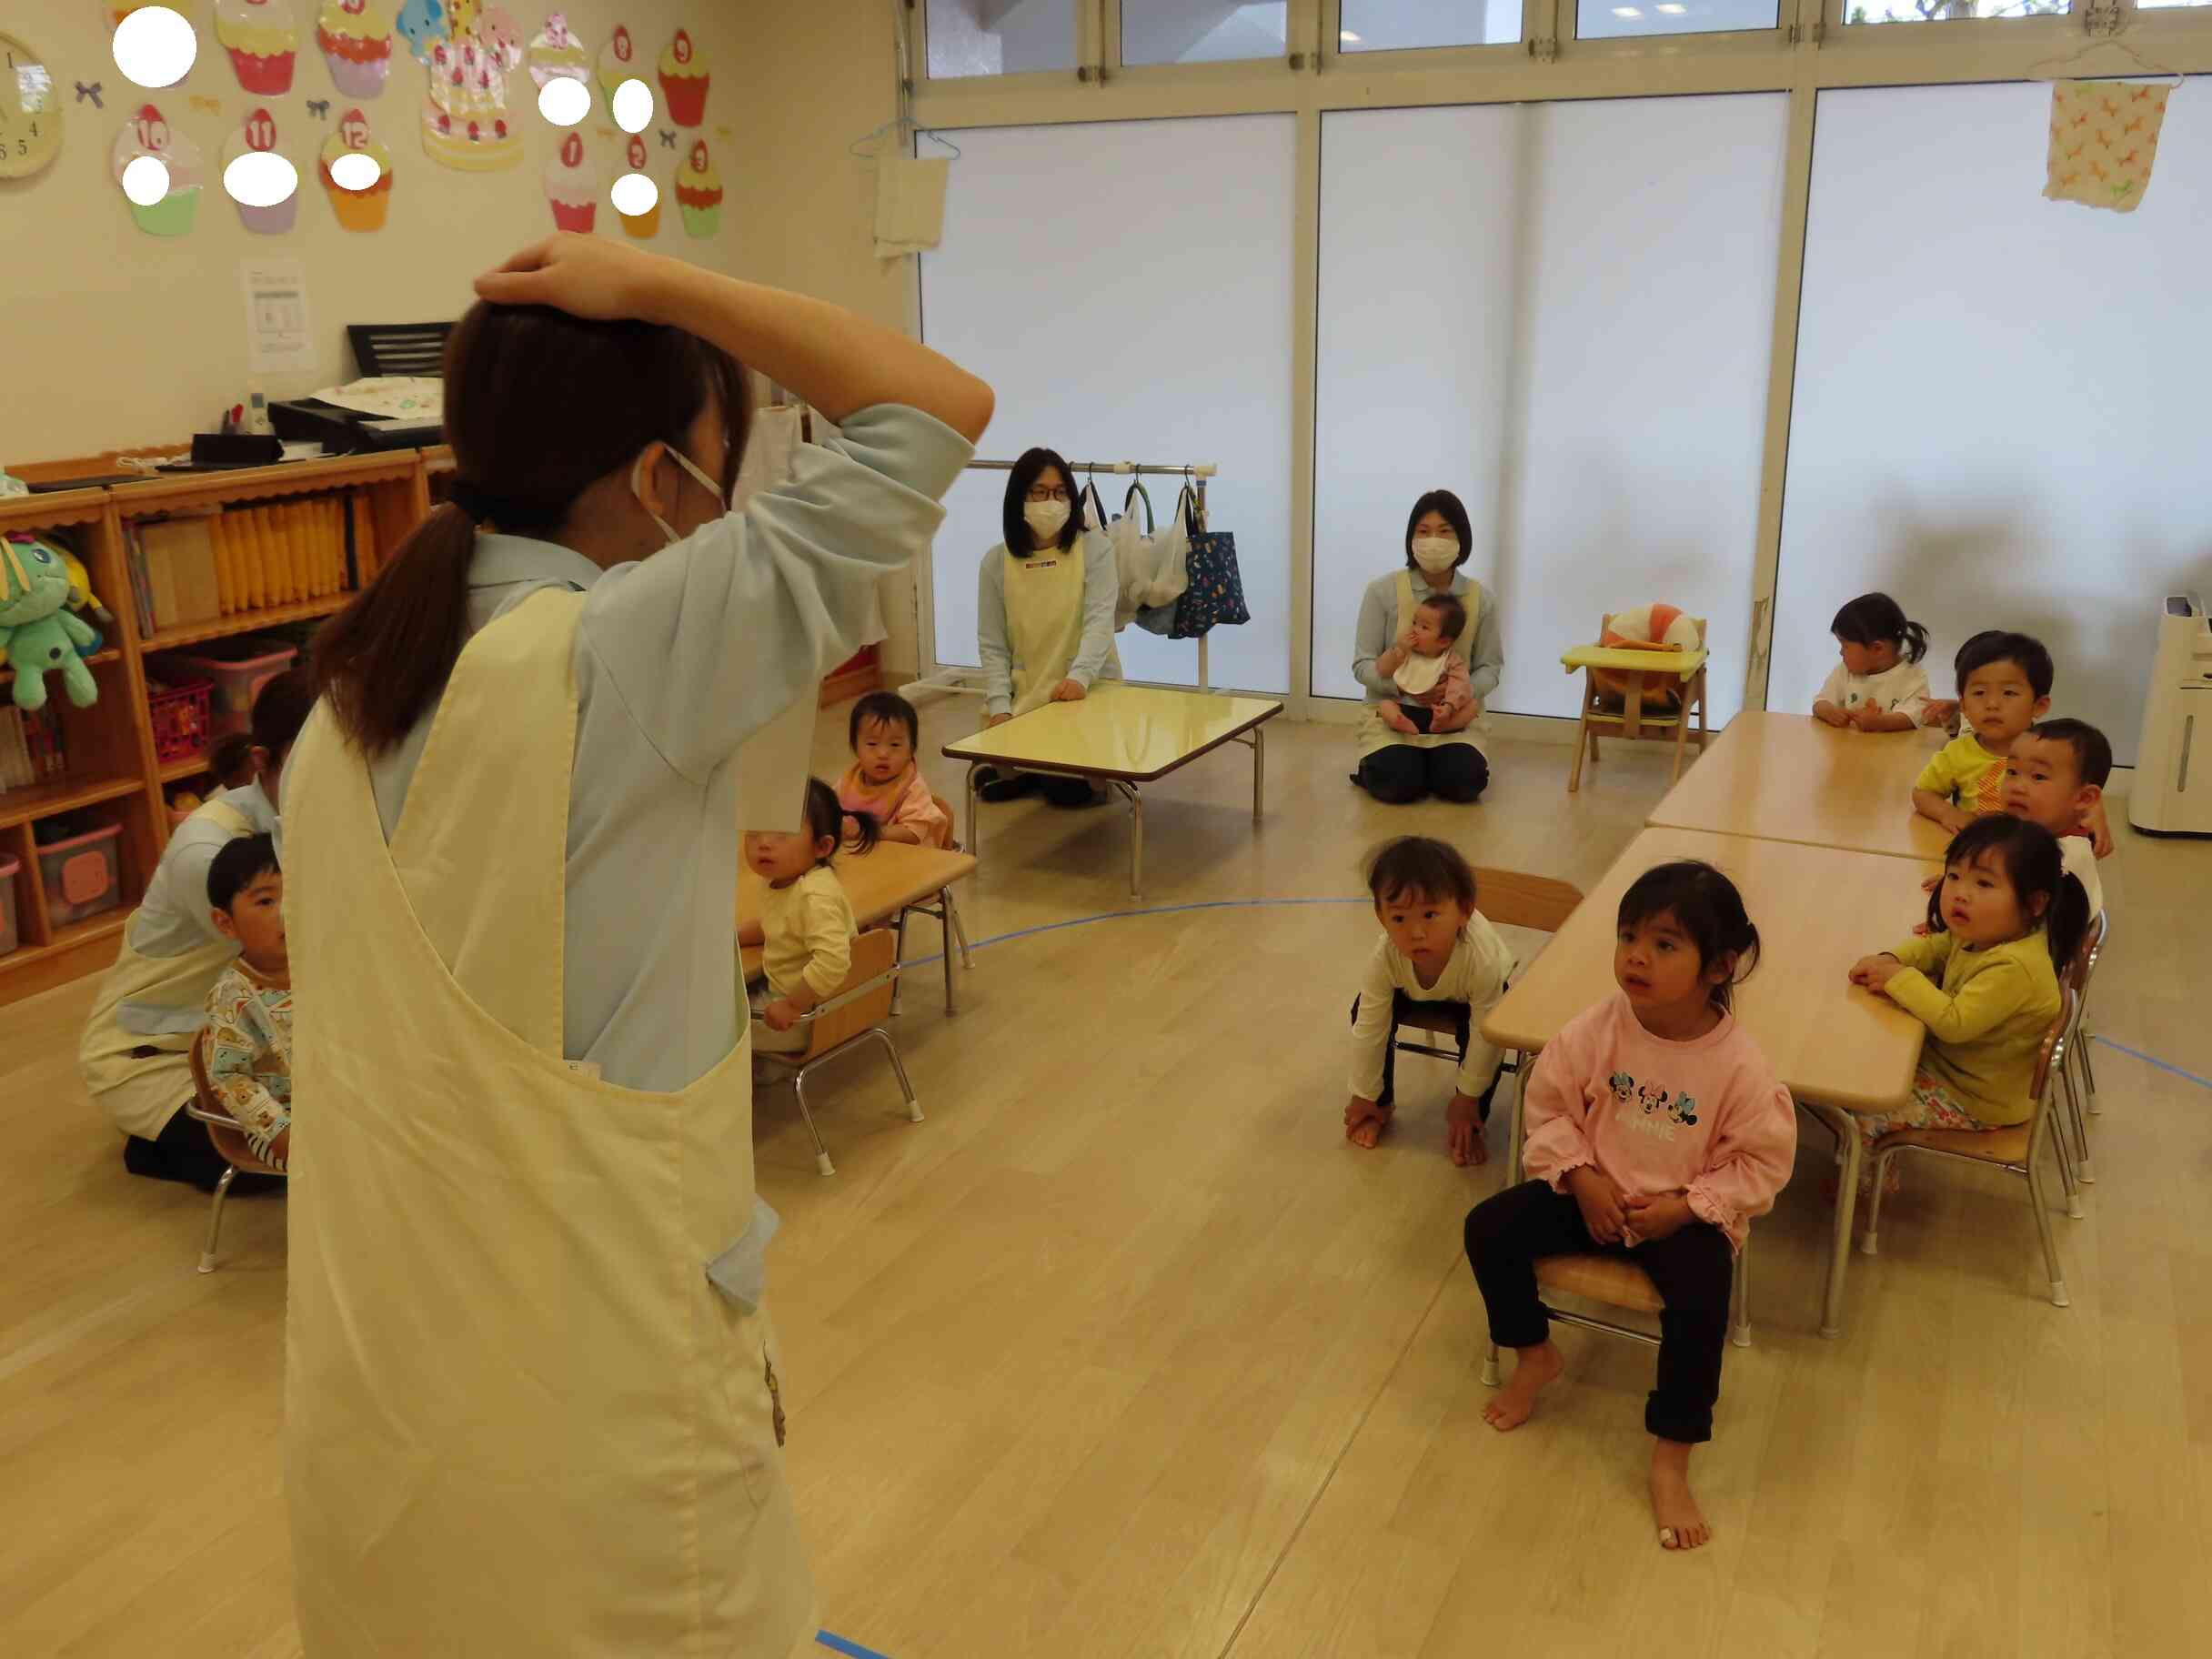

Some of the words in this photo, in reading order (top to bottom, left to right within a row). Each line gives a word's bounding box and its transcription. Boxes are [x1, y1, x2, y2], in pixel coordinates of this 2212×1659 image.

[7, 52, 14, 69] 1
[29, 121, 38, 137] 4
[249, 120, 272, 146] 11
[343, 120, 369, 147] 12
[18, 139, 27, 156] 5
